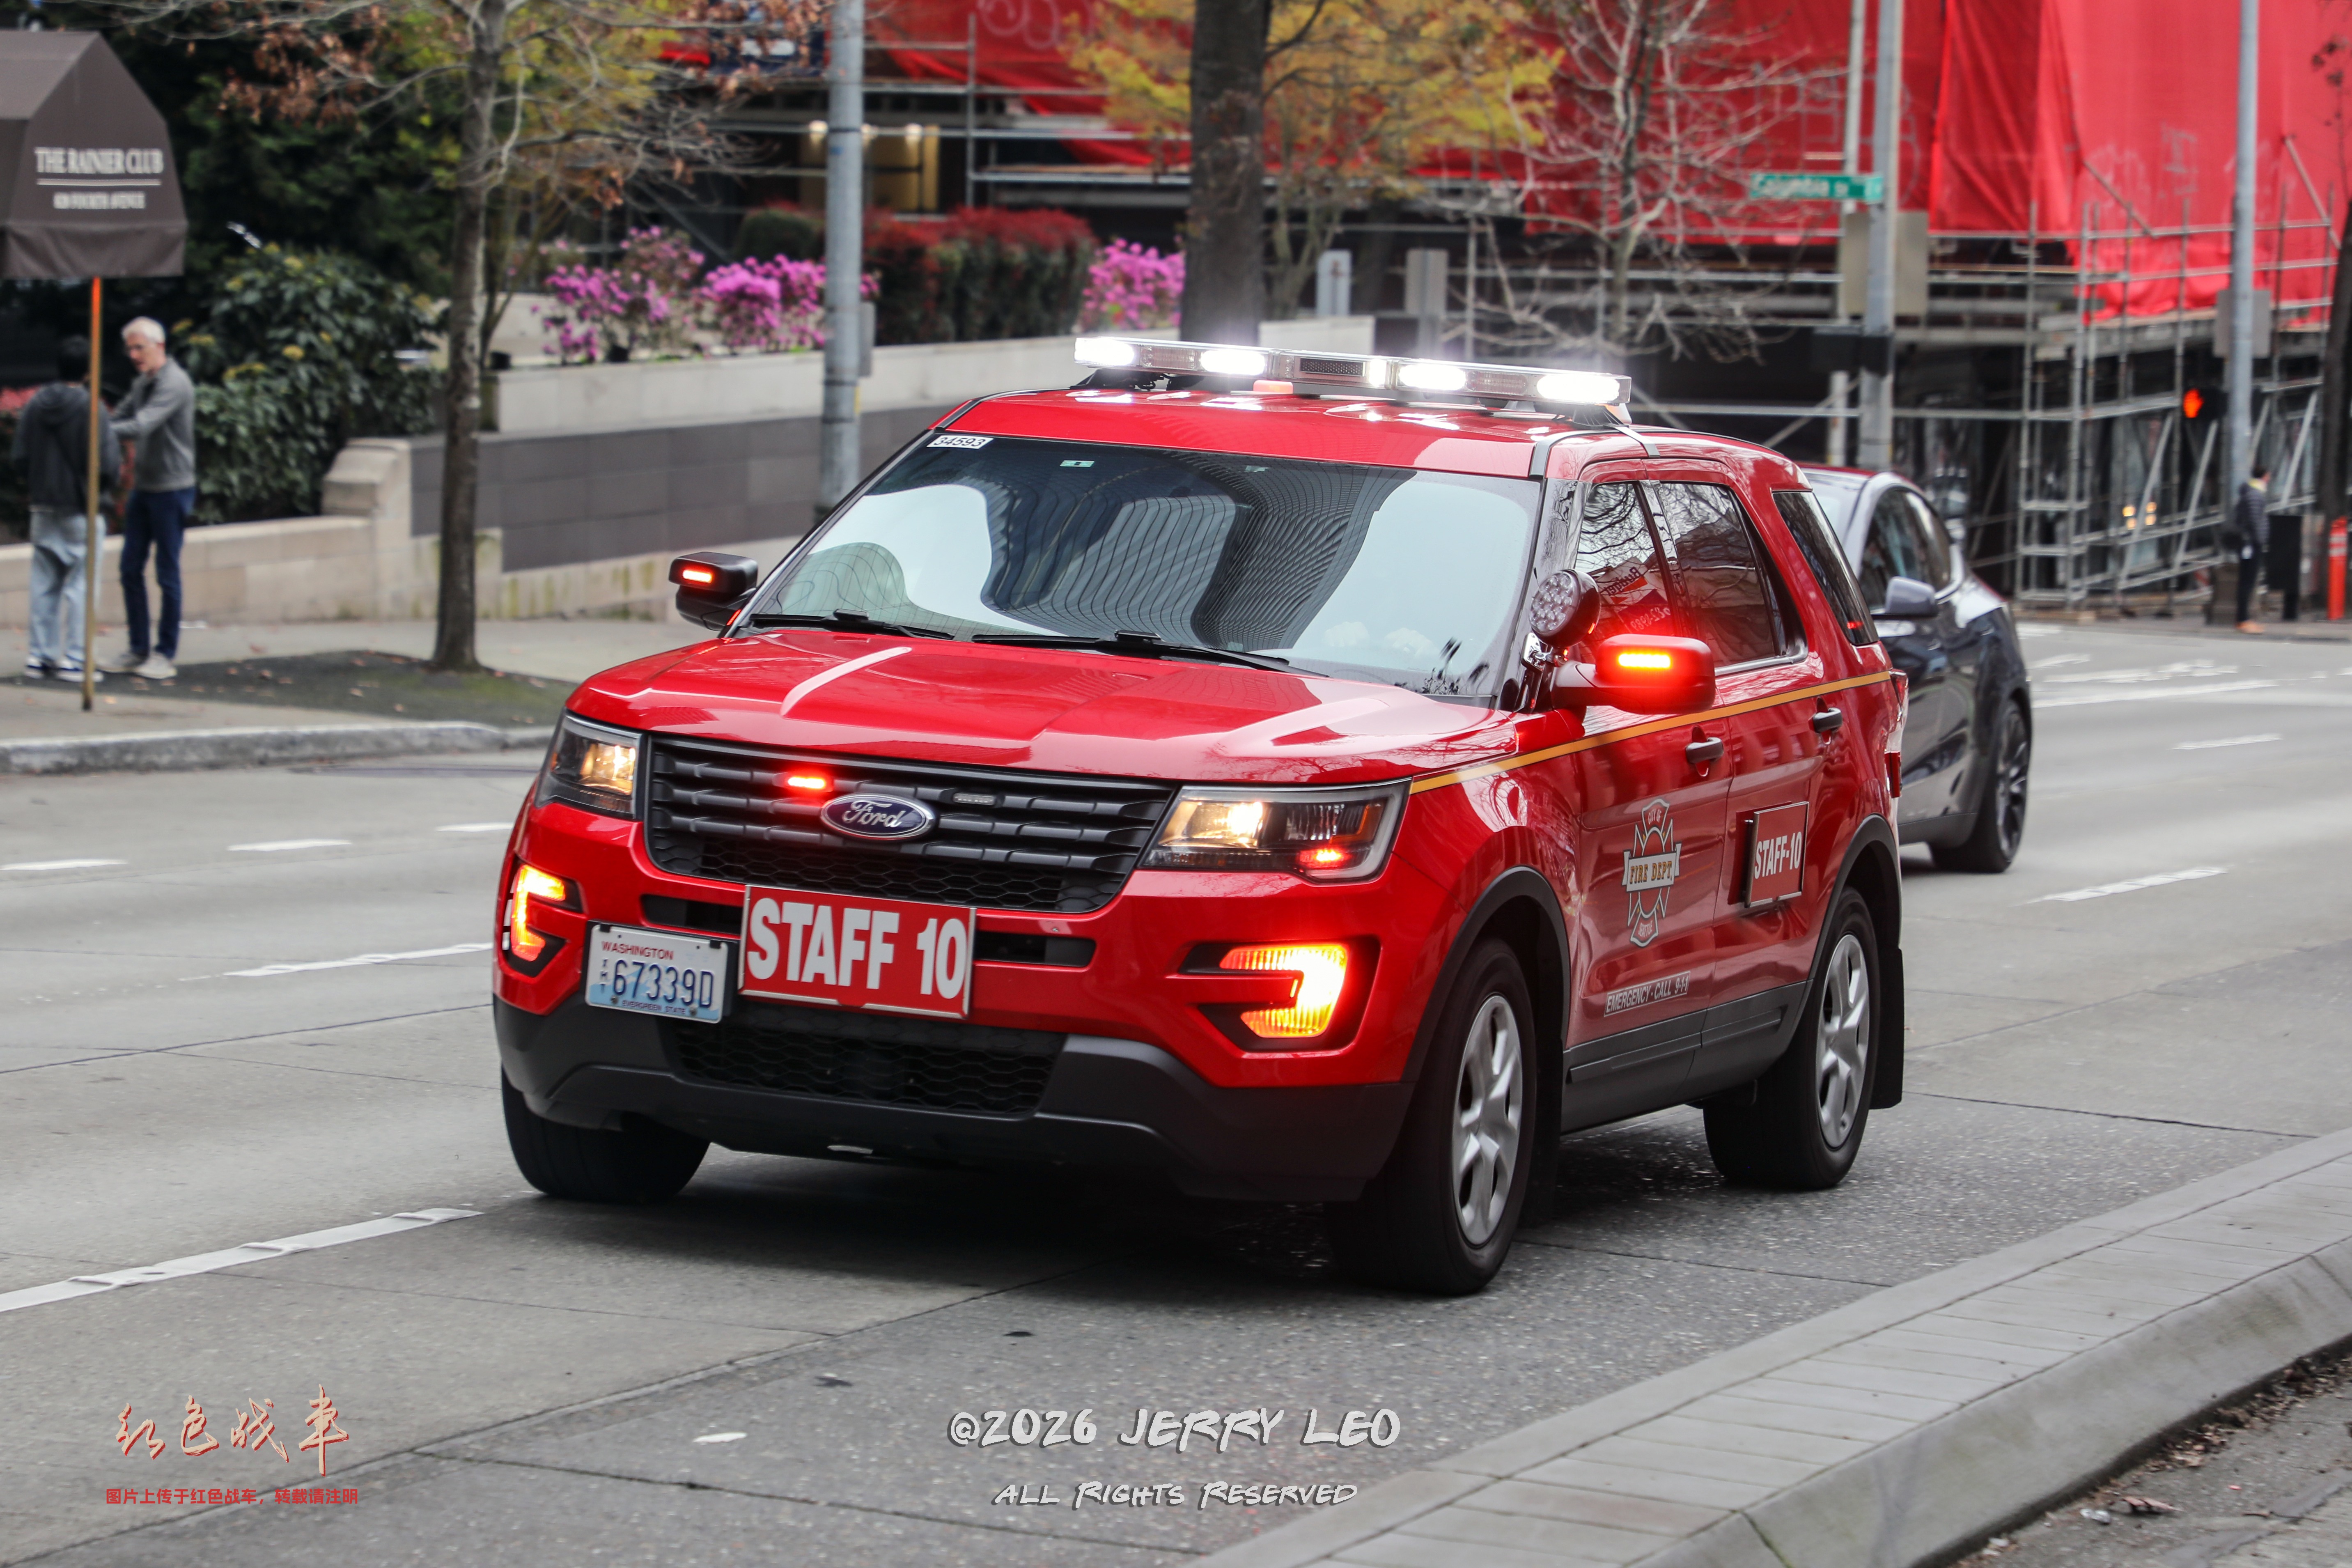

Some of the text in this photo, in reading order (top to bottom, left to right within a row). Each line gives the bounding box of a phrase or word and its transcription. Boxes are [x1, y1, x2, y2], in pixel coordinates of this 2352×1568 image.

[34, 147, 67, 172] THE
[934, 437, 986, 447] 34593
[842, 800, 906, 828] Ford
[1656, 809, 1661, 823] OF
[1754, 831, 1802, 879] STAFF-10
[1629, 864, 1648, 884] FIRE
[1638, 920, 1653, 937] SEATTLE
[601, 941, 674, 960] WASHINGTON
[748, 898, 967, 999] STAFF 10
[613, 960, 714, 1008] 67339D
[1675, 975, 1689, 994] 9-1-1
[622, 1000, 686, 1015] EVERGREEN STATE
